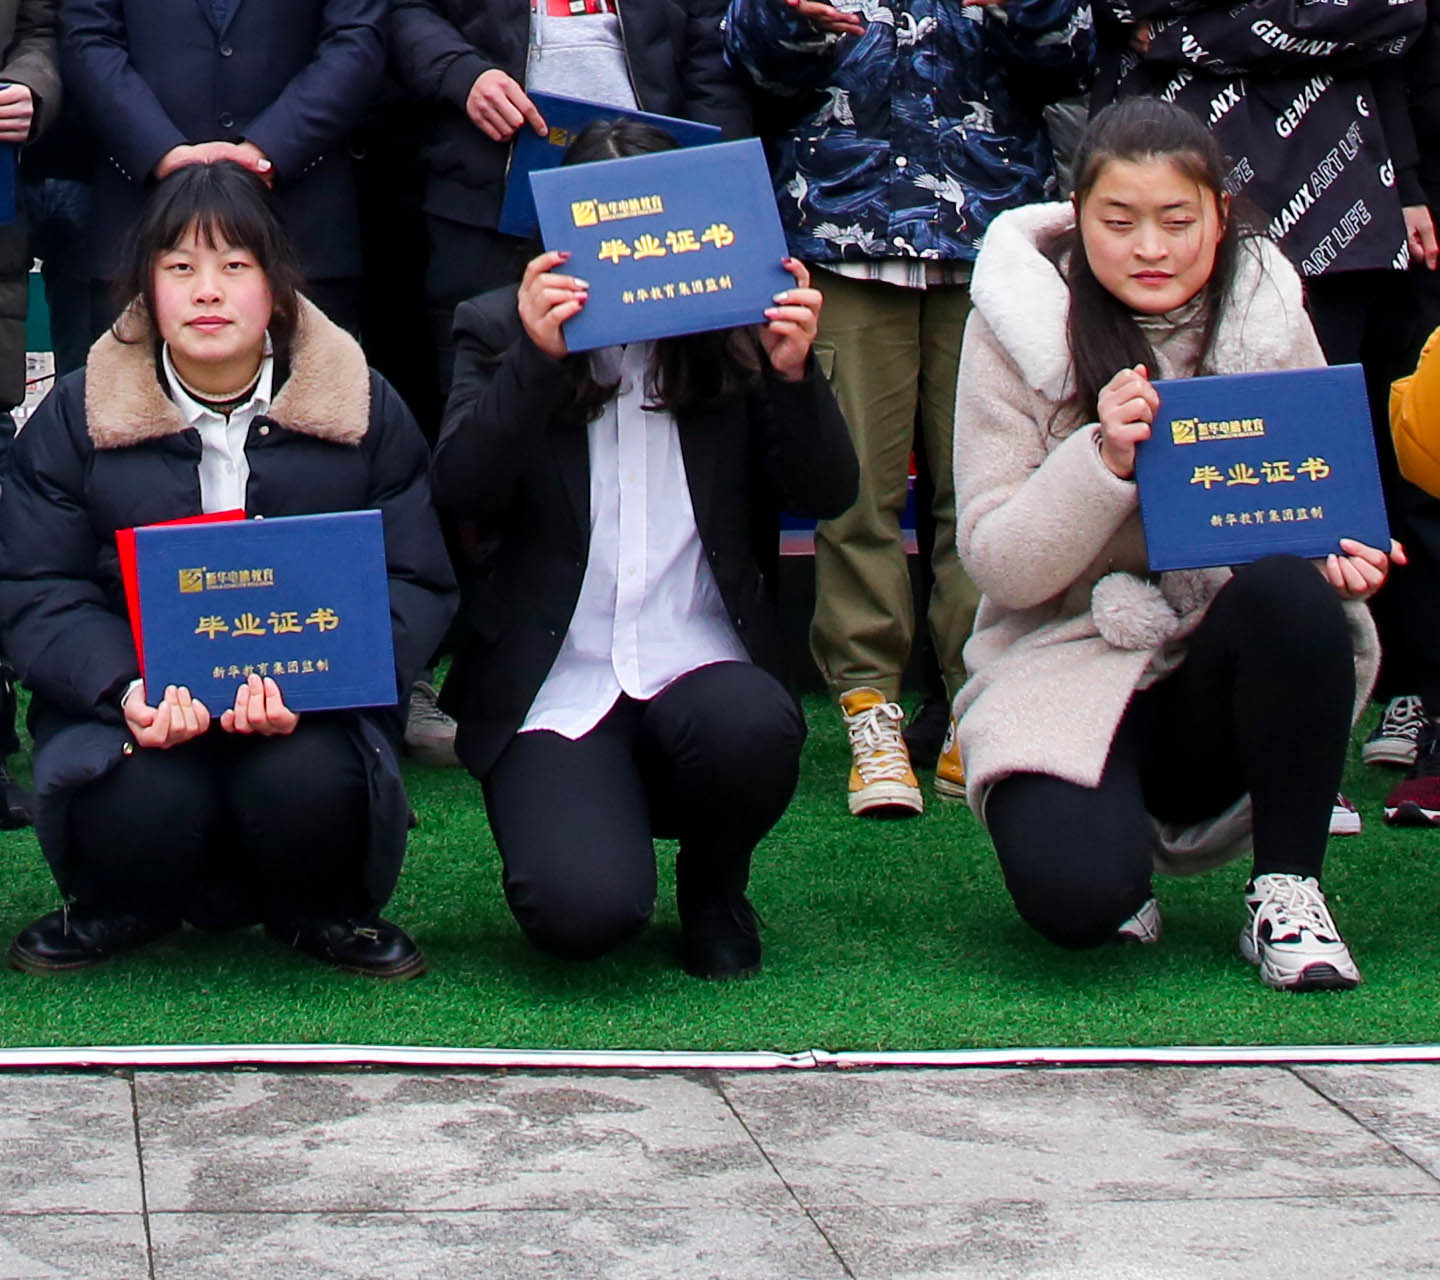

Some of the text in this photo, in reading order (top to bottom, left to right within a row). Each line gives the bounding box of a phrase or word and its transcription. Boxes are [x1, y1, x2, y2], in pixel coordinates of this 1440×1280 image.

[1250, 19, 1339, 56] GENANX
[1221, 156, 1256, 197] IFE
[1310, 148, 1347, 198] ART
[598, 223, 735, 264] 毕业证书
[1301, 199, 1373, 277] ART LIFE
[1190, 457, 1331, 489] 毕业证书
[1210, 506, 1324, 528] 新华教育集团监制
[206, 568, 274, 586] 新华电脑教育
[194, 608, 340, 640] 毕业证书
[212, 659, 329, 680] 新华教育集团监制
